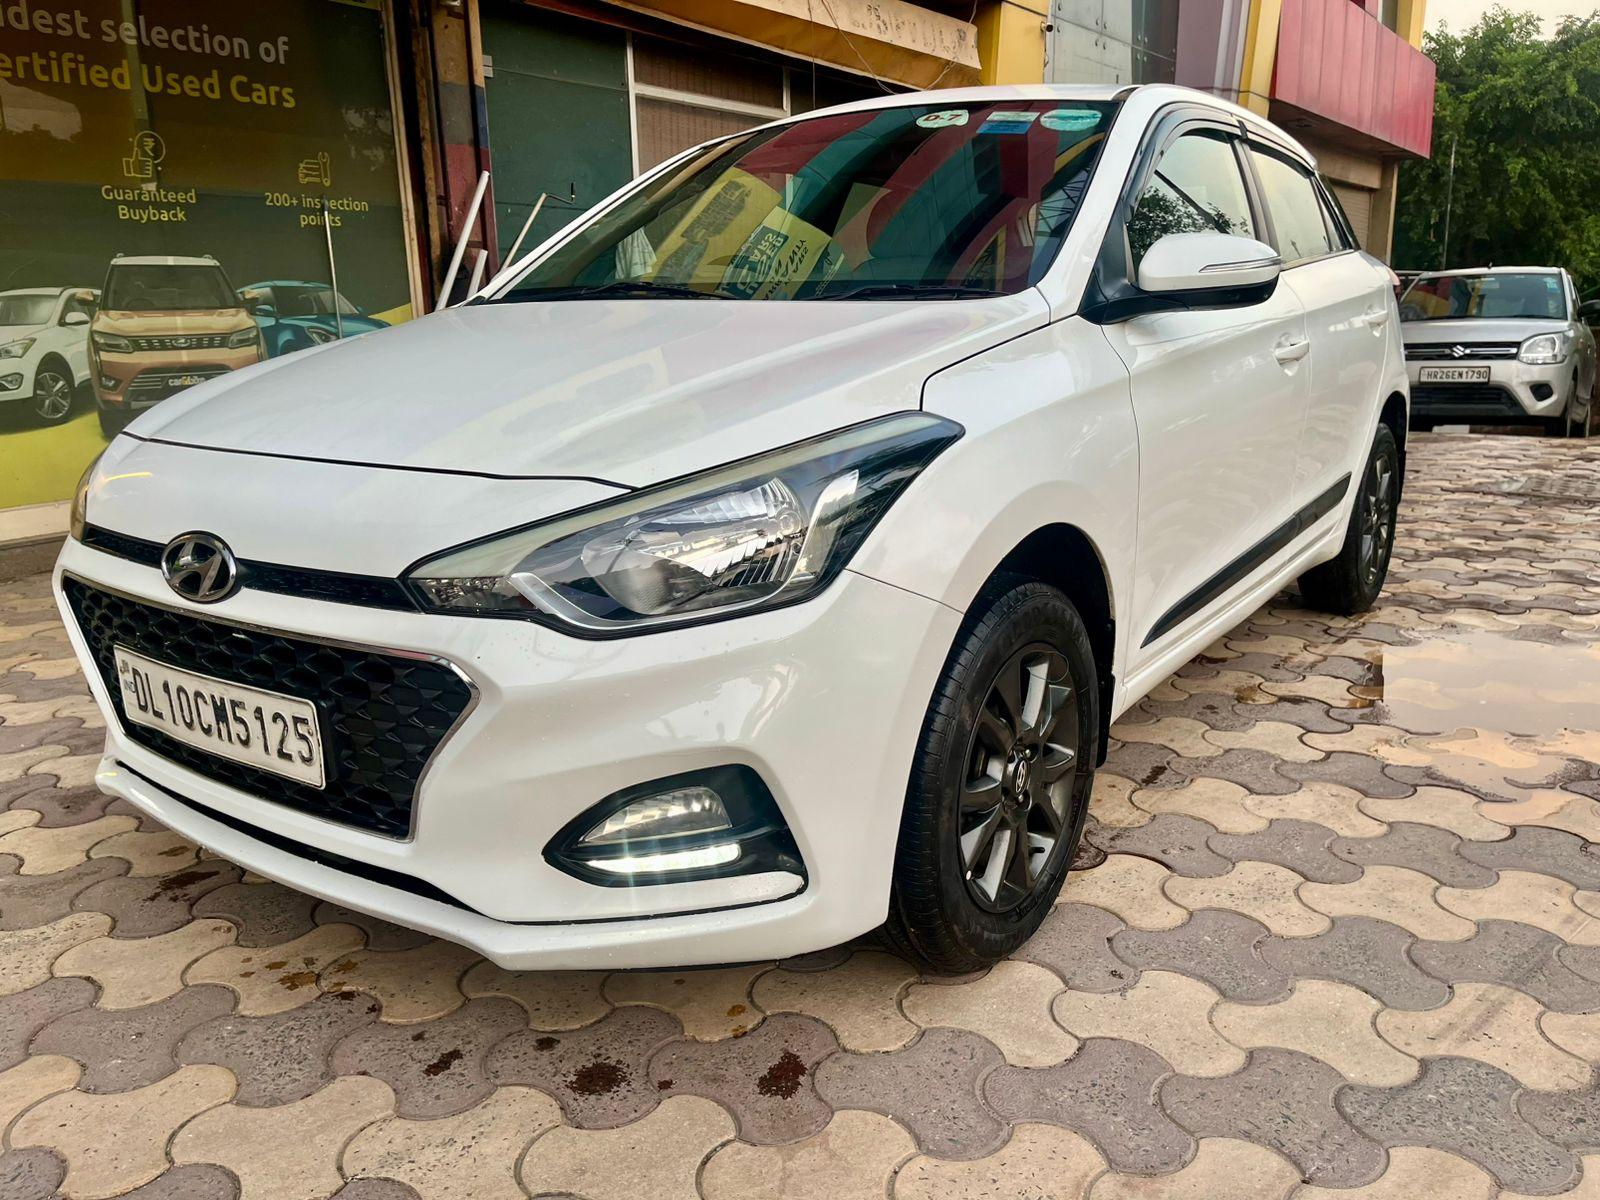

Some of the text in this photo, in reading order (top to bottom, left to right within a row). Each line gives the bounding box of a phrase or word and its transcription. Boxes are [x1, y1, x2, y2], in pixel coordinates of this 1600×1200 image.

[101, 15, 249, 59] selection
[259, 36, 289, 65] of
[142, 64, 220, 99] Used
[230, 75, 296, 108] Cars
[923, 113, 962, 122] D-7
[101, 184, 196, 203] Guaranteed
[264, 192, 299, 206] 200+
[118, 205, 186, 224] Buyback
[1427, 369, 1488, 380] HR26EN1790
[132, 667, 314, 767] DL10CM5125
